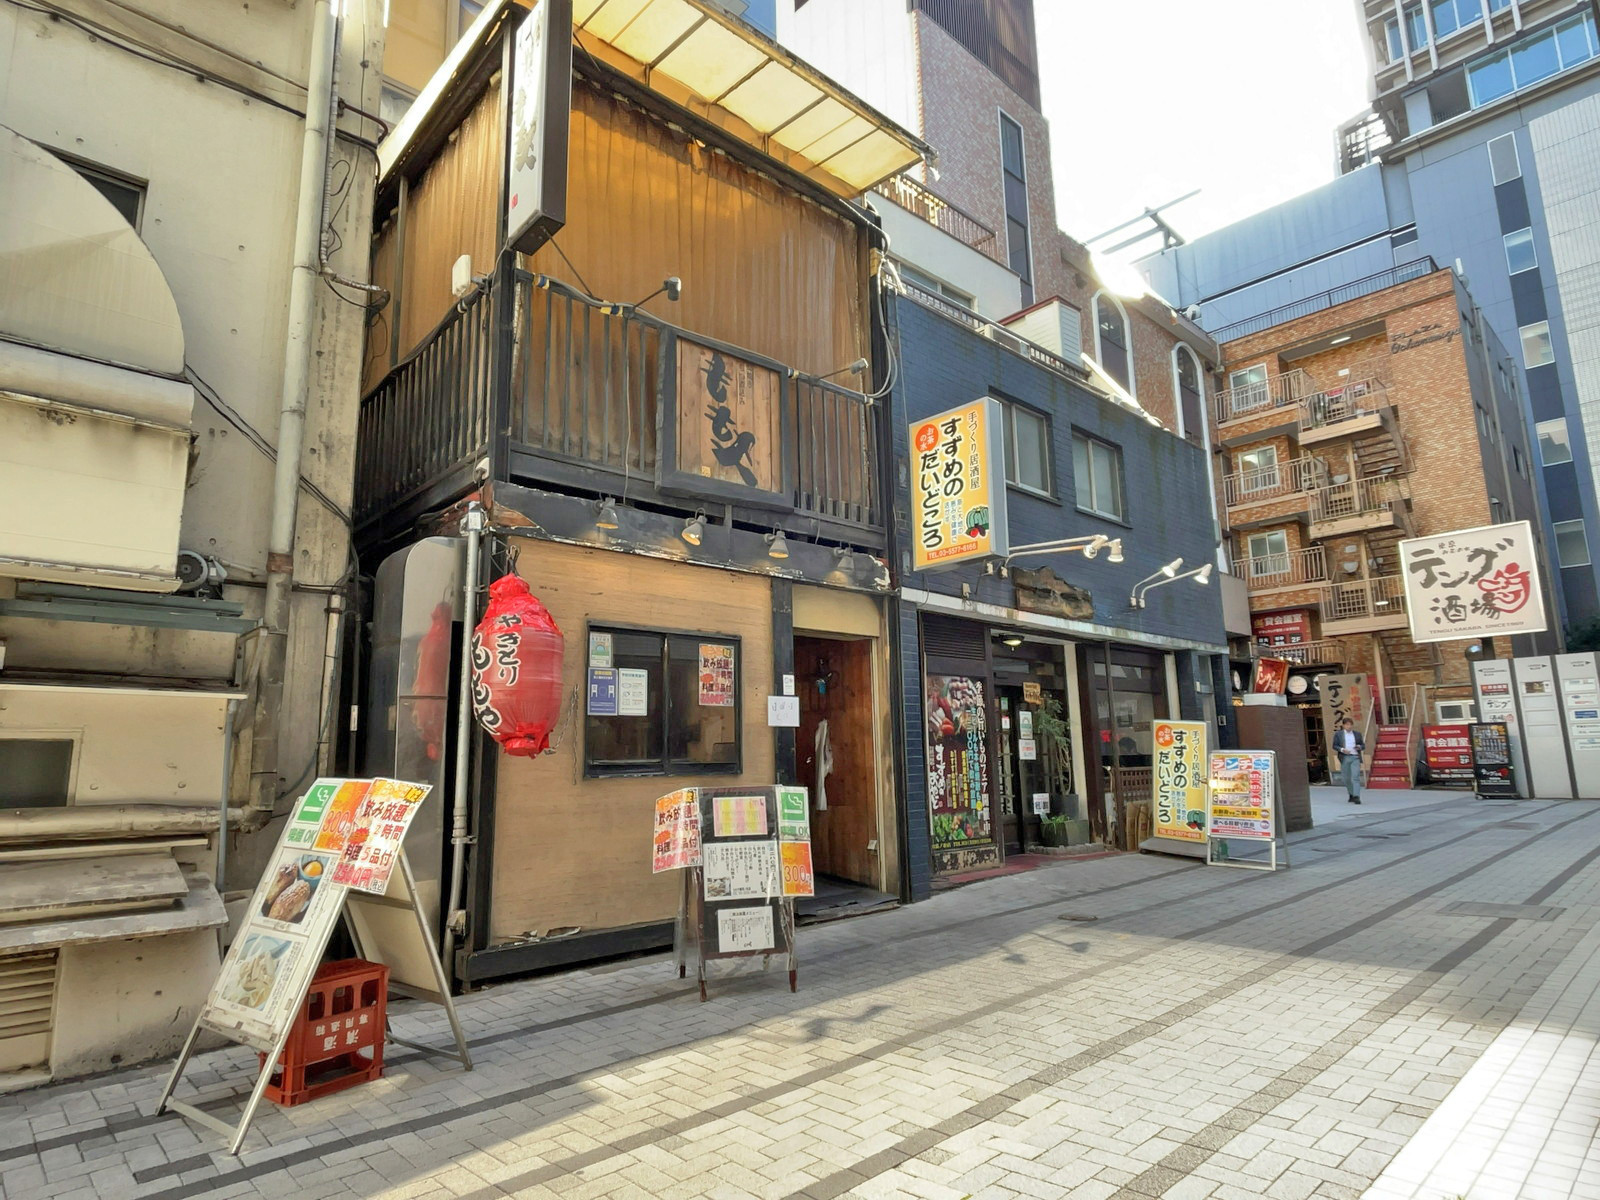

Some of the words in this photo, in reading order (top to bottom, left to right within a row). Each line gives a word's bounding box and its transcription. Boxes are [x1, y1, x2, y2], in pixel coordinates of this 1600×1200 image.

[941, 417, 965, 497] すずめの
[968, 410, 980, 490] 手づくり居酒屋
[920, 448, 943, 549] だいどころ
[1409, 537, 1515, 590] テング
[1429, 594, 1500, 624] 酒場
[497, 614, 522, 686] やきとり
[1327, 680, 1352, 732] テング
[1173, 730, 1187, 788] すずめの
[362, 800, 410, 823] 飲み放題
[1159, 751, 1171, 823] だいどころ
[343, 843, 393, 866] 料理5品付
[323, 1029, 359, 1052] 清酒
